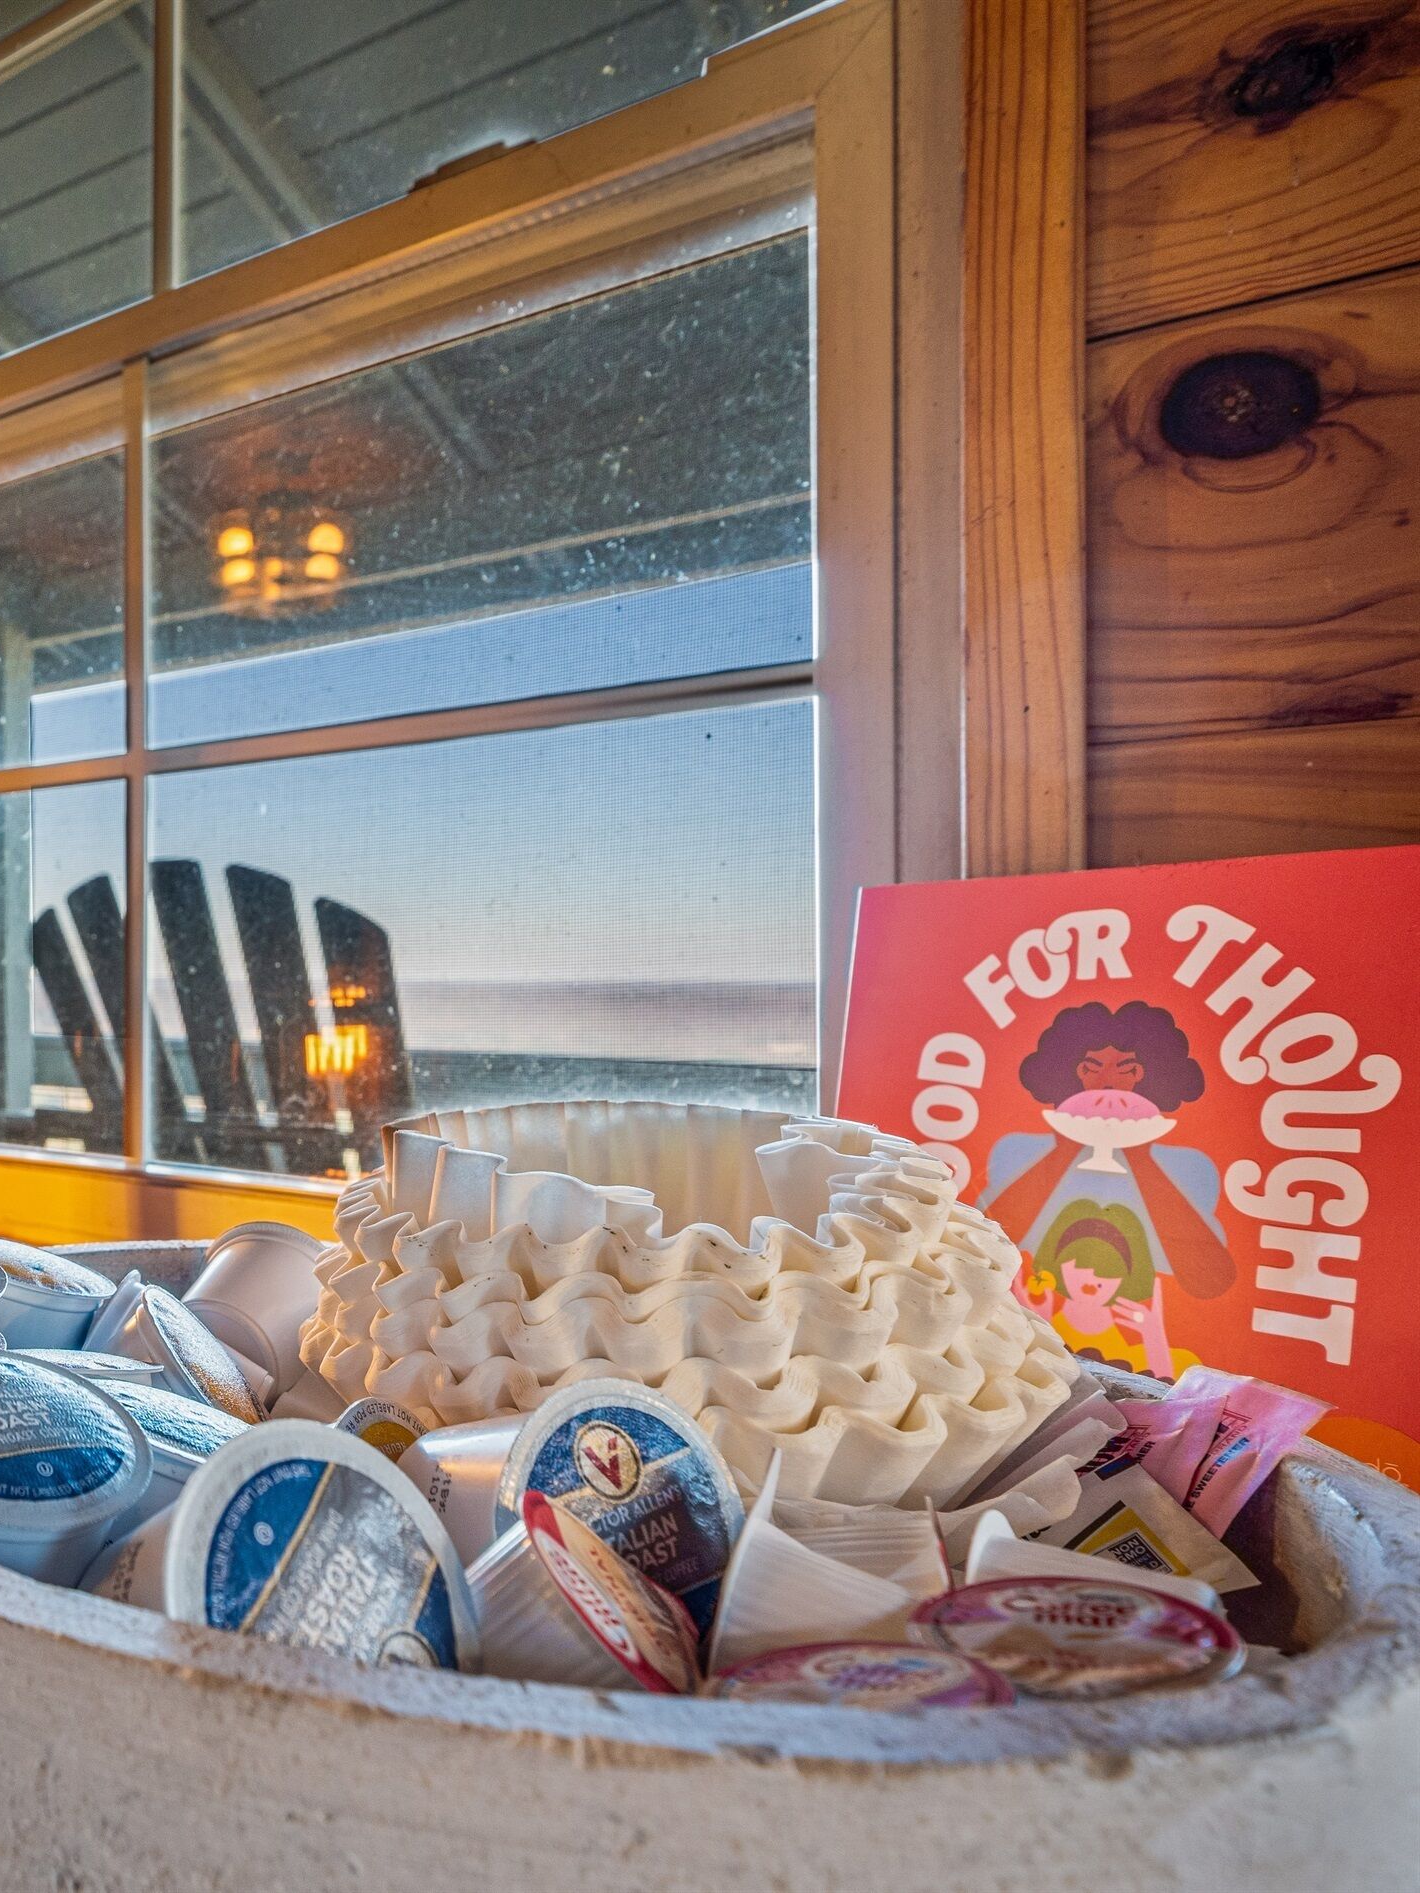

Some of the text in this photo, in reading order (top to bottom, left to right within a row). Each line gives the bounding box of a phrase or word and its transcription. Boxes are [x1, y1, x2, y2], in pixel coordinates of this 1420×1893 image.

[963, 908, 1132, 1029] FOR
[1166, 904, 1402, 1366] THOUGHT
[352, 1409, 368, 1423] FOR
[367, 1402, 396, 1416] LABELED
[397, 1407, 411, 1425] NOT
[1190, 1436, 1251, 1499] SWEETENER
[10, 1484, 30, 1498] NOT
[1110, 1537, 1139, 1557] NON
